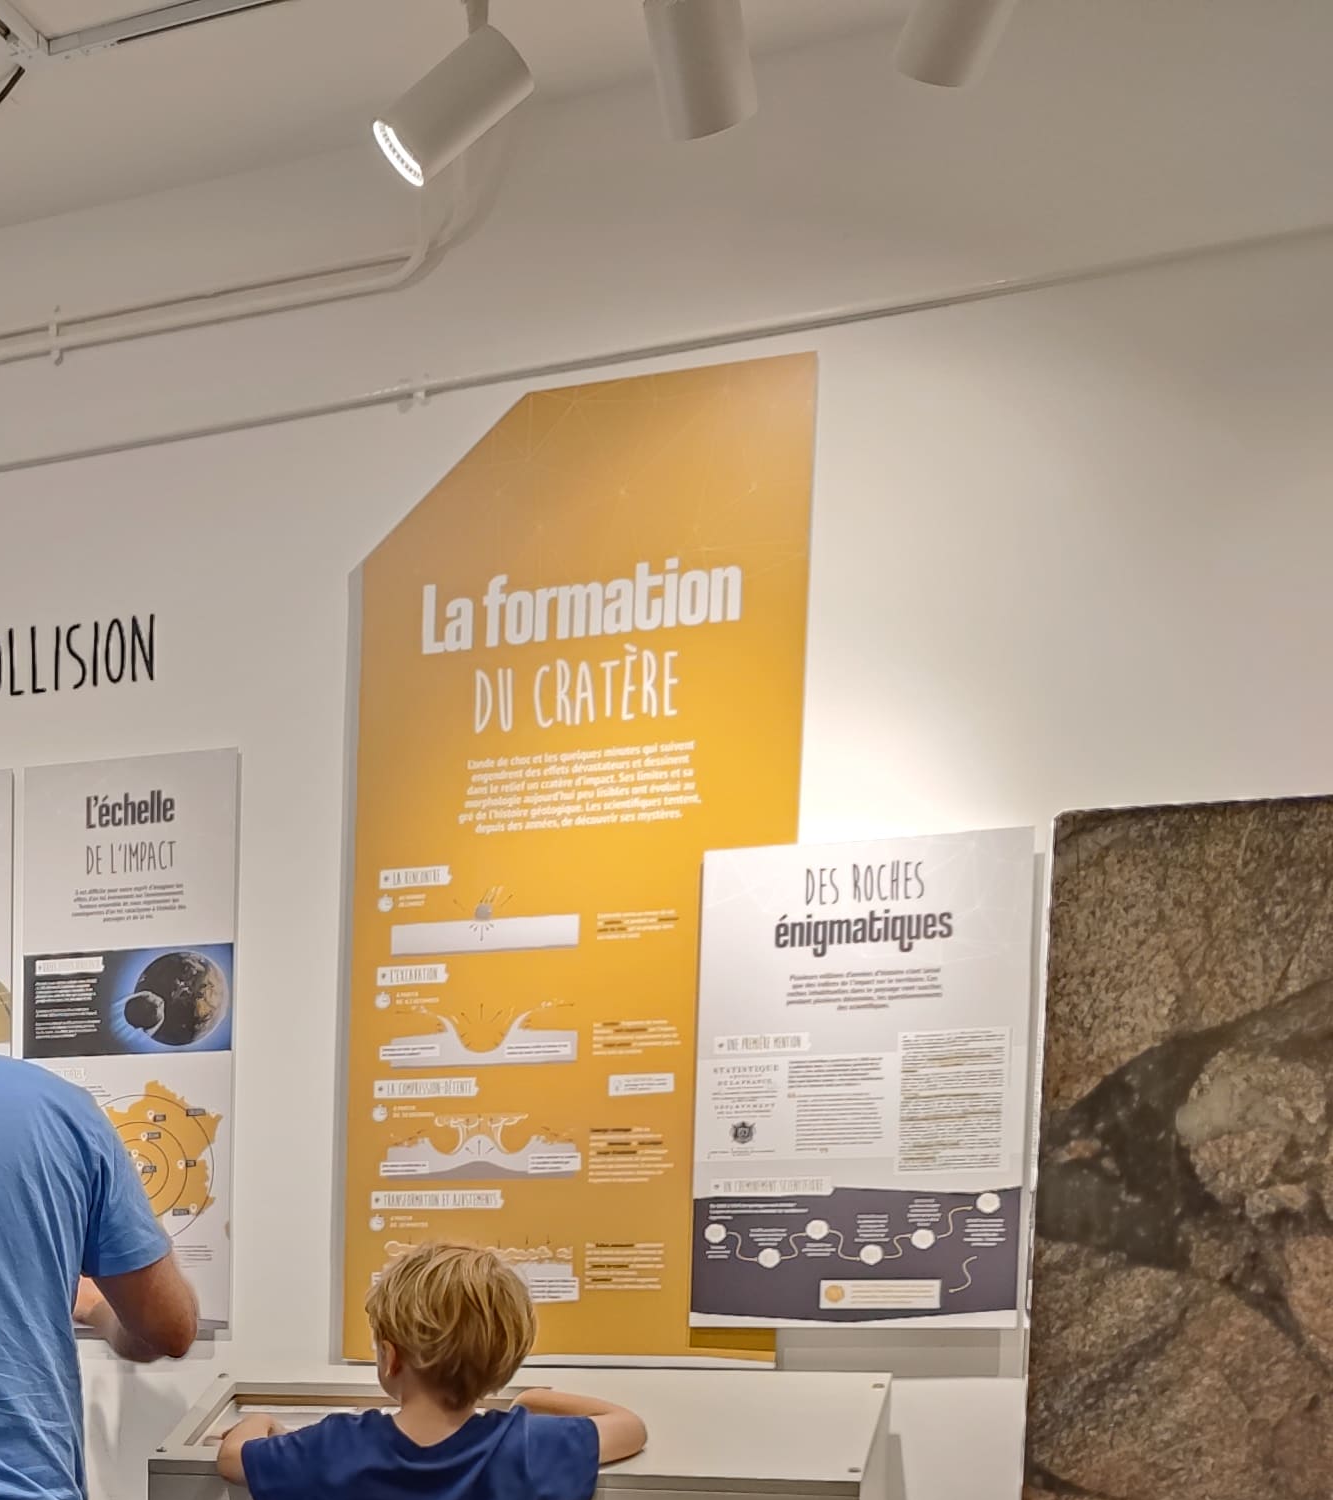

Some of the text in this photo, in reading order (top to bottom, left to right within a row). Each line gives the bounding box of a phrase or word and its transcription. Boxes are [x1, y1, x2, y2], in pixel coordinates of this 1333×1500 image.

[422, 557, 742, 655] La formation
[474, 643, 679, 734] DU CRATÈRE
[86, 790, 175, 829] L'échelle
[86, 841, 177, 876] DE L'IMPACT
[805, 860, 926, 905] DES ROCHES
[774, 909, 953, 957] énigmatiques
